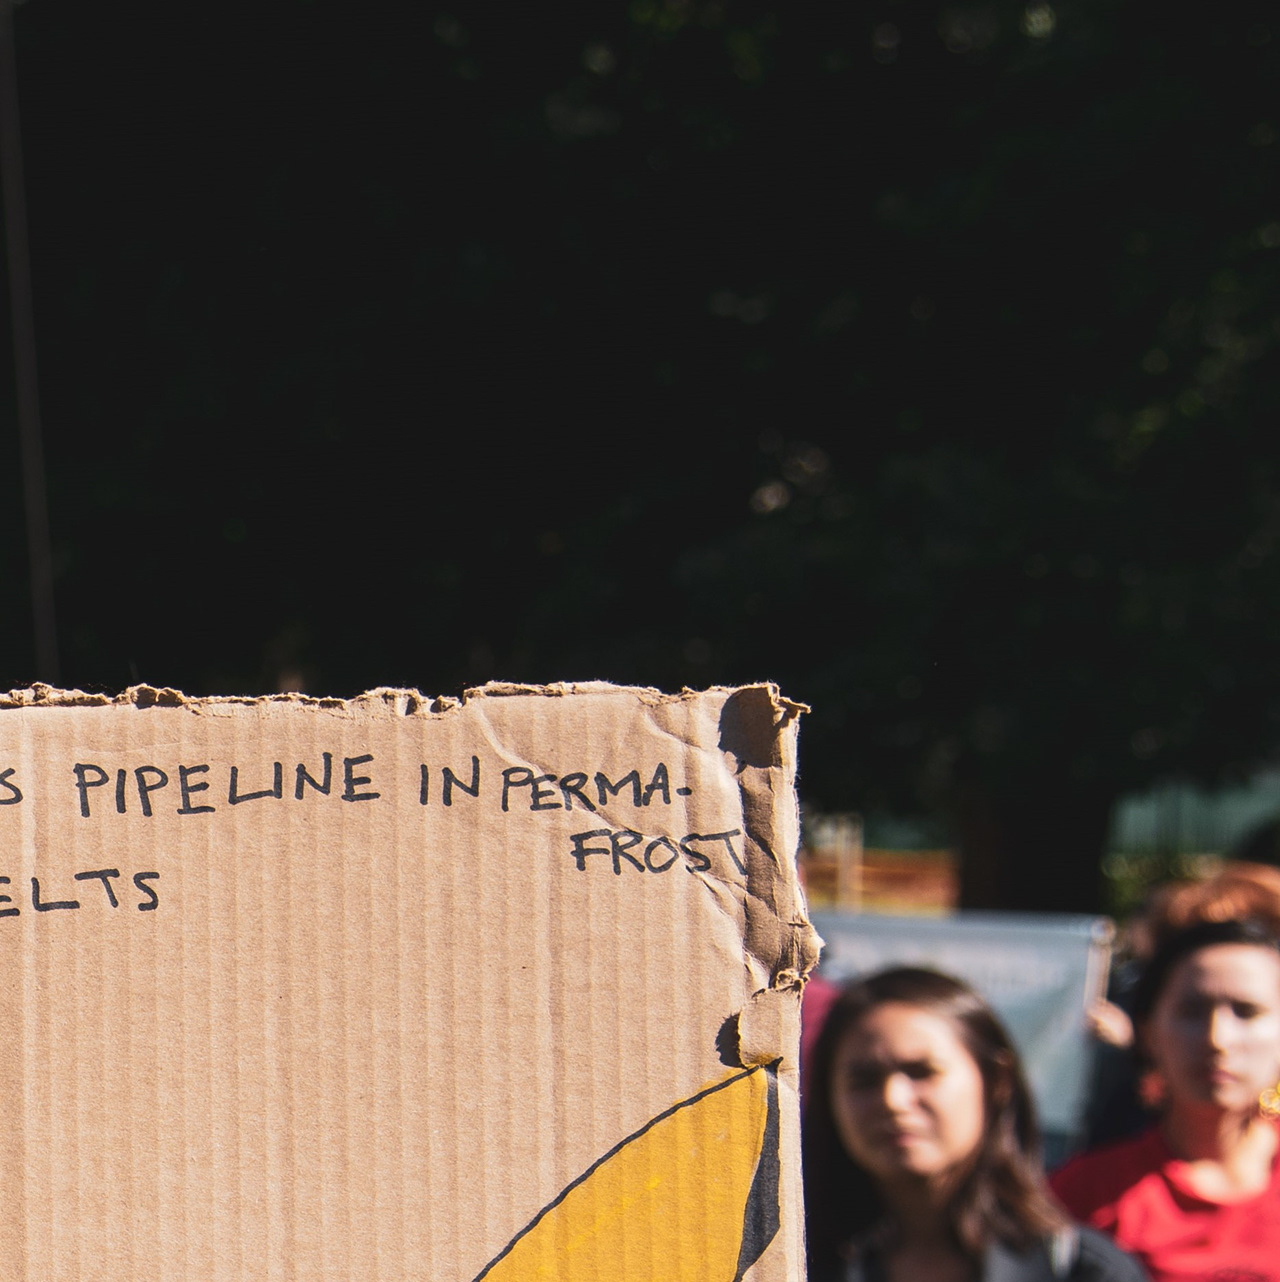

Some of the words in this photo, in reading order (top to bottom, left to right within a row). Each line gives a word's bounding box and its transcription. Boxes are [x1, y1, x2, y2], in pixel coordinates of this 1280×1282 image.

[72, 752, 381, 818] PIPELINE
[419, 755, 480, 807] IN
[501, 762, 693, 812] PERMA-
[569, 827, 748, 876] FROST
